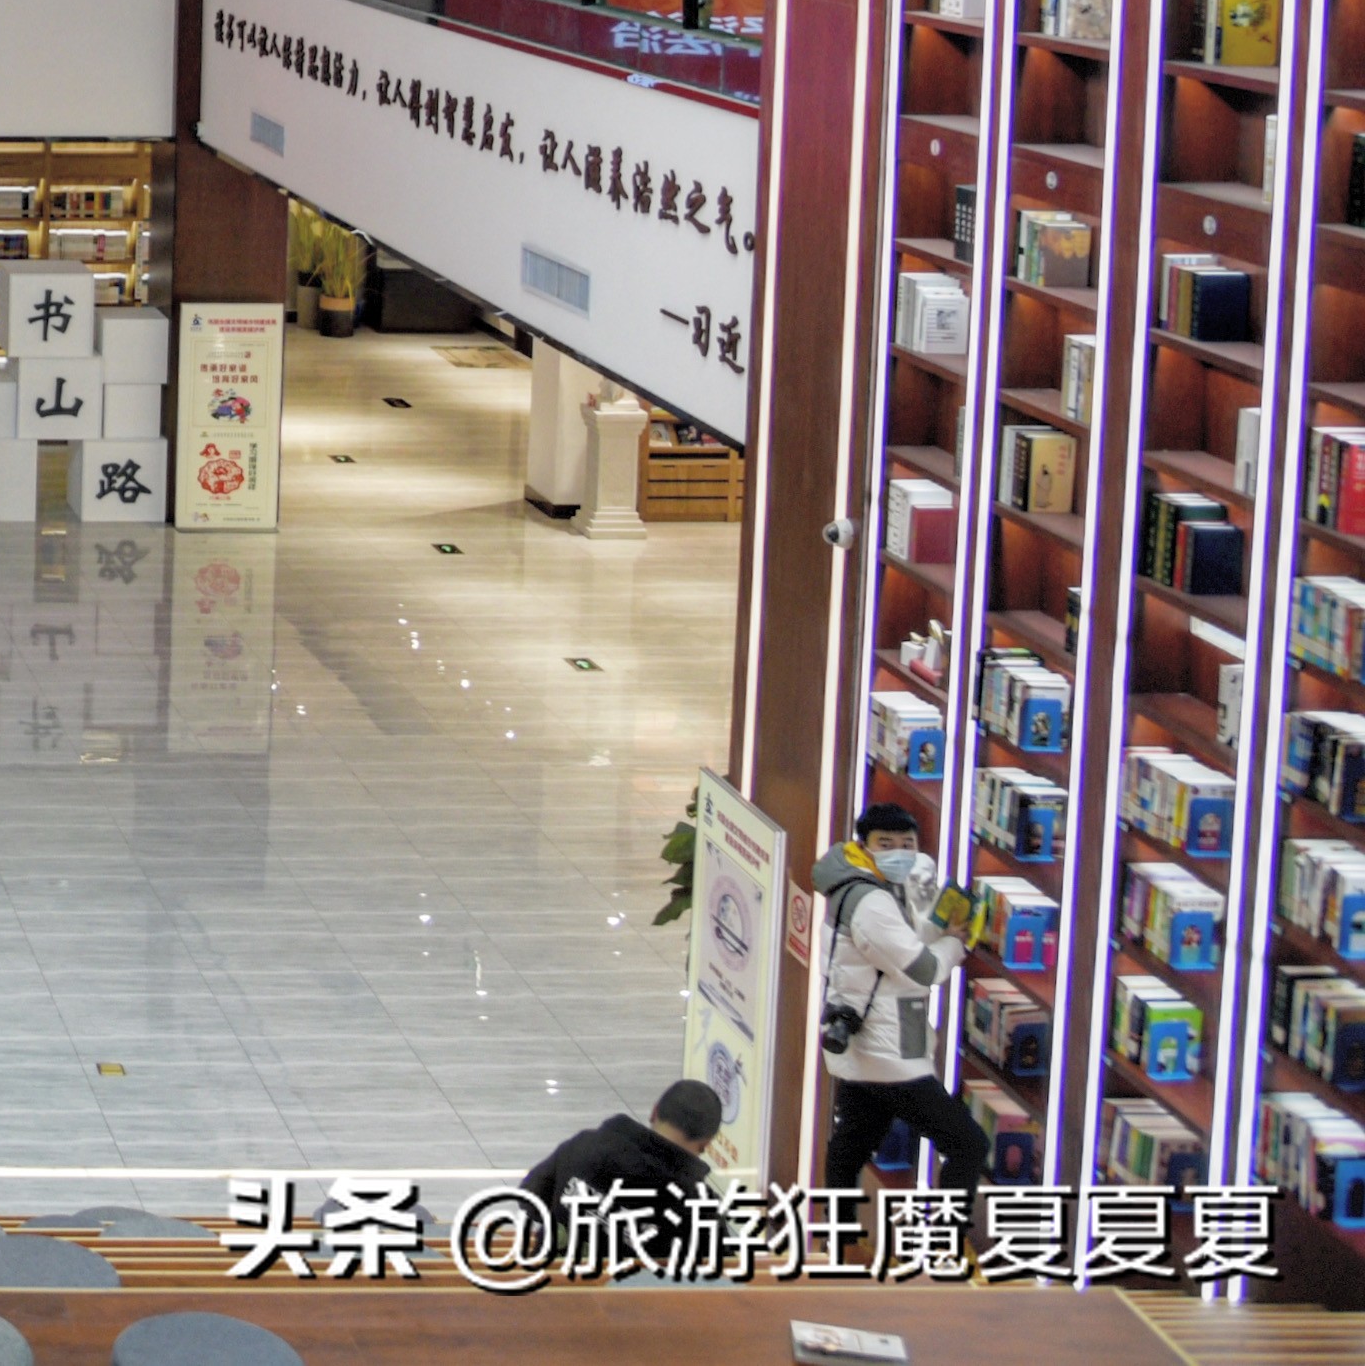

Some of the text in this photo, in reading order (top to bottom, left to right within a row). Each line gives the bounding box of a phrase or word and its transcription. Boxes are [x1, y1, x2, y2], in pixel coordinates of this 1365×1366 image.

[28, 289, 74, 341] 书
[35, 377, 83, 418] 山
[96, 459, 152, 503] 路
